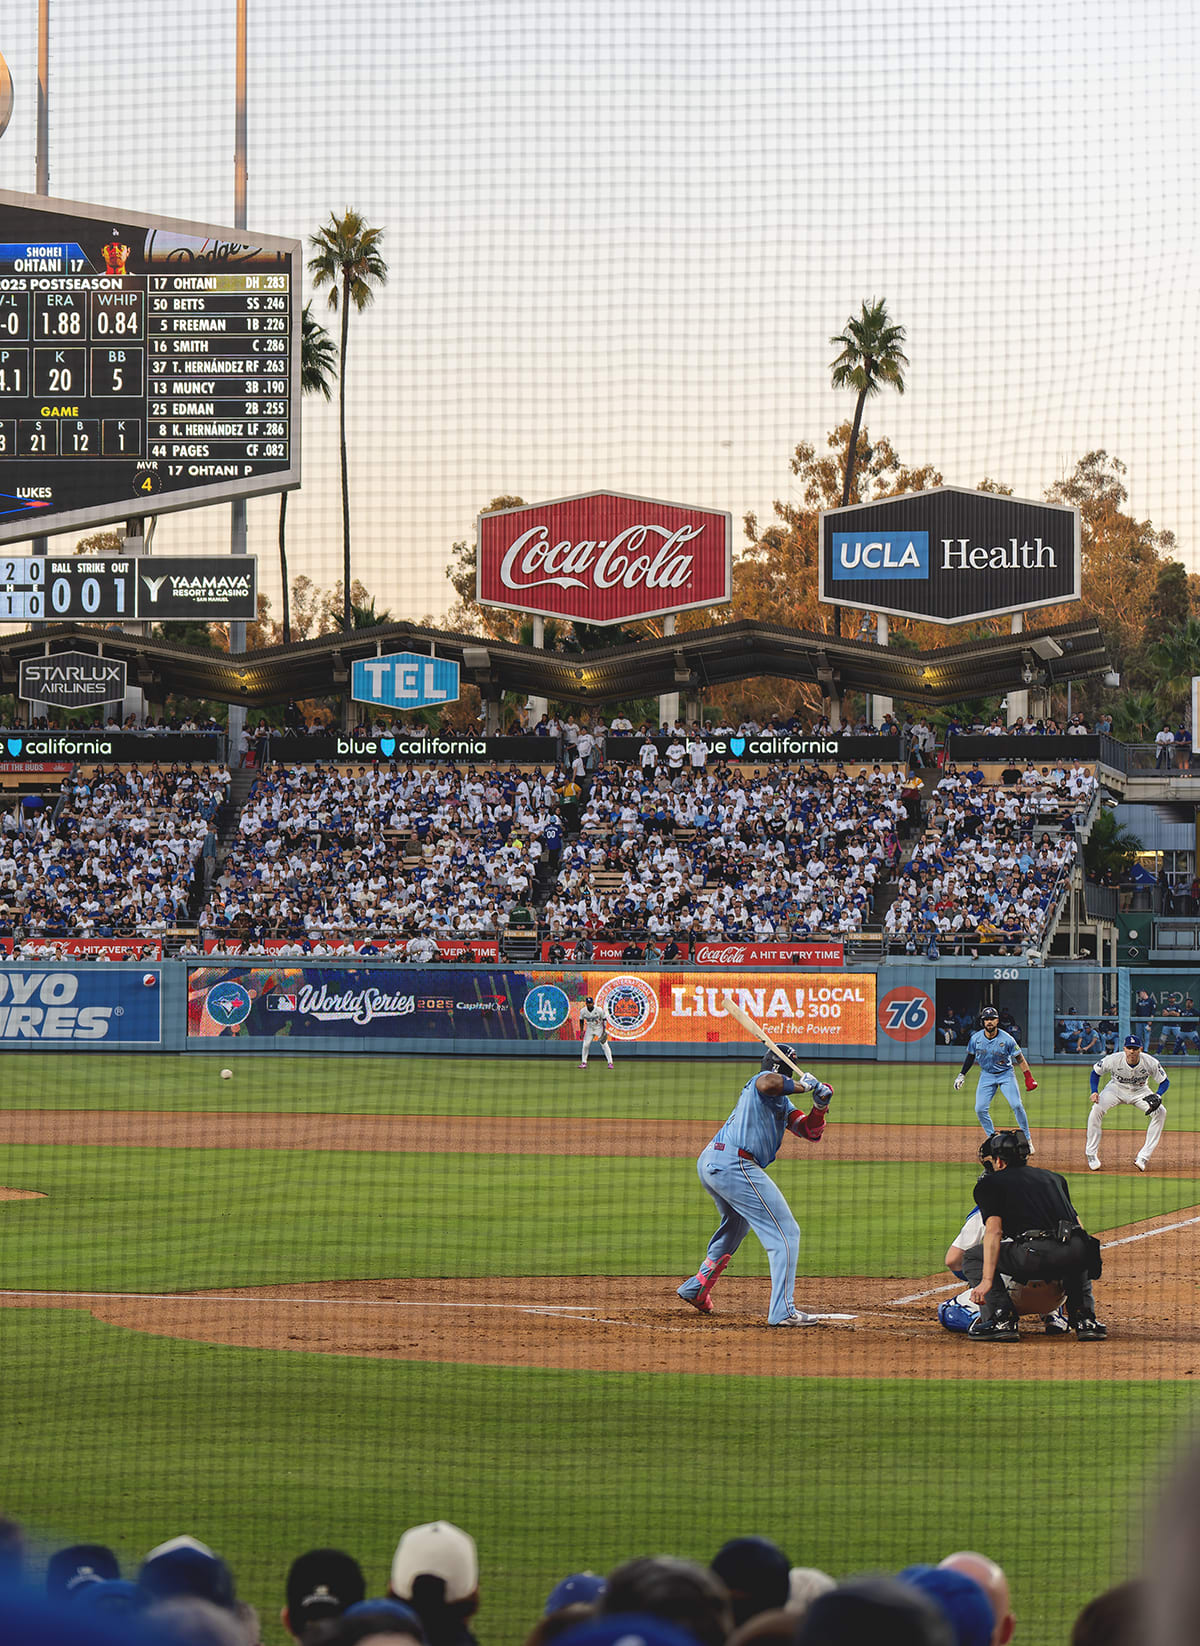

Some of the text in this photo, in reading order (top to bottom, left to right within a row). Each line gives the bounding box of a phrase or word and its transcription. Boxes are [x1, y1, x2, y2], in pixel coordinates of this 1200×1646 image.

[26, 246, 62, 258] SHOHEI
[14, 258, 84, 272] OHTANI 17
[31, 279, 122, 290] POSTSEASON
[155, 277, 284, 290] 17 OHTANI DH .283
[48, 295, 73, 305] ERA
[98, 294, 137, 305] WHIP
[43, 312, 80, 334] 1.88
[98, 312, 137, 334] 0.84
[161, 319, 284, 331] 5 FREEMAN 1B .226
[153, 358, 284, 373] 37 T. HERNÁNDEZ RF .263
[152, 444, 284, 456] 44 PAGES CF .082
[169, 466, 252, 475] 17 OHTANI P
[16, 487, 52, 499] LUKES
[500, 523, 706, 590] Coca-Cola
[840, 538, 1057, 570] UCLA Health
[5, 562, 15, 581] 2
[29, 562, 40, 581] 0
[51, 563, 130, 573] BALL STRIKE OUT
[6, 584, 14, 593] H
[32, 584, 38, 593] E
[51, 577, 125, 614] 0 0 1
[172, 589, 249, 597] RESORT & CASINO
[6, 596, 13, 615] 1
[29, 596, 40, 615] 0
[25, 666, 120, 681] STARLUX
[364, 663, 447, 698] TEL
[40, 683, 106, 693] AIRLINES
[26, 738, 112, 754] california
[337, 738, 486, 754] blue california
[685, 738, 838, 754] bue california
[696, 946, 747, 964] Coca-Cola
[750, 951, 758, 960] A
[759, 951, 778, 960] HIT
[815, 951, 841, 960] TIME
[993, 969, 1019, 980] 360
[298, 984, 363, 1015] World
[357, 987, 416, 1025] Series
[417, 999, 454, 1010] 2025
[670, 986, 865, 1018] LiUNA! LOCAL
[808, 1003, 841, 1018] 300
[885, 997, 927, 1030] 76
[762, 1022, 842, 1034] Feel the Power
